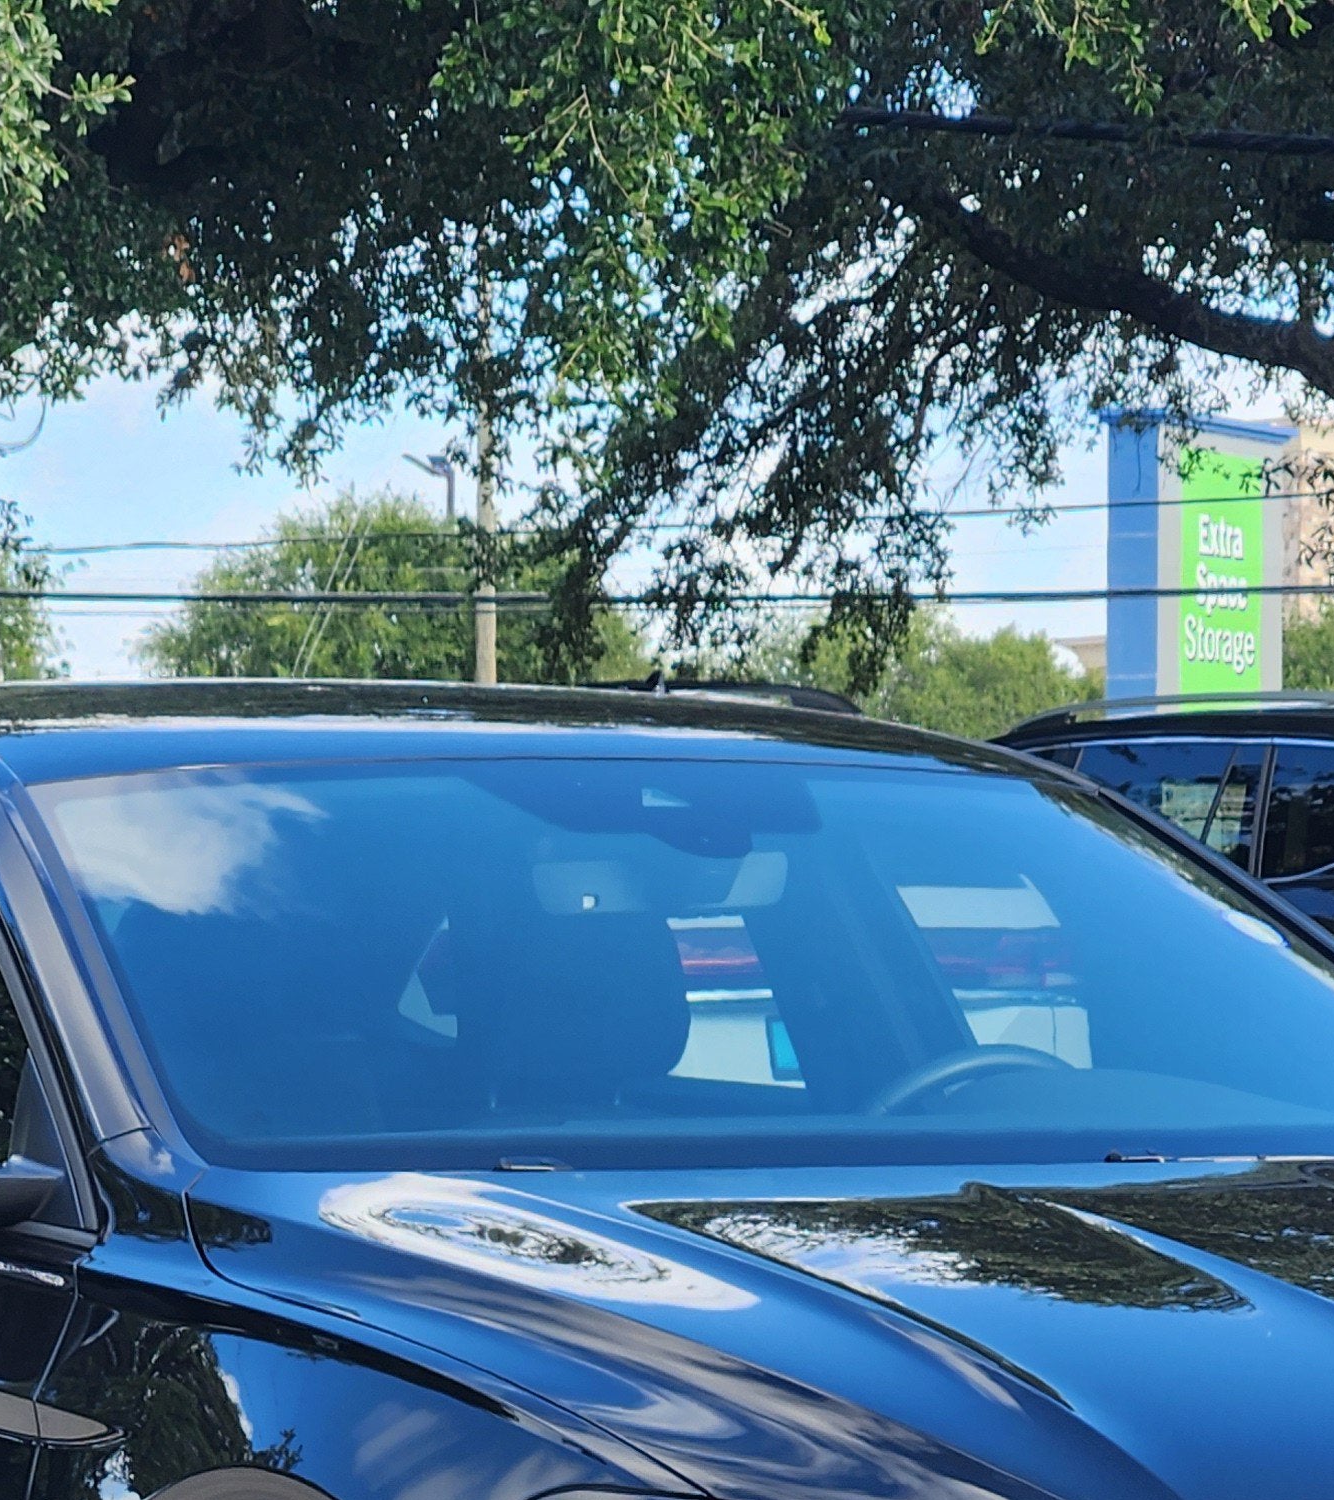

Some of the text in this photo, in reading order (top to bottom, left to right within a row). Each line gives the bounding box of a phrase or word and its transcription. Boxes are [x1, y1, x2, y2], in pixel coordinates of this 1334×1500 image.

[1198, 513, 1244, 560] Extra
[1195, 562, 1248, 615] Space
[1184, 613, 1256, 674] Storage
